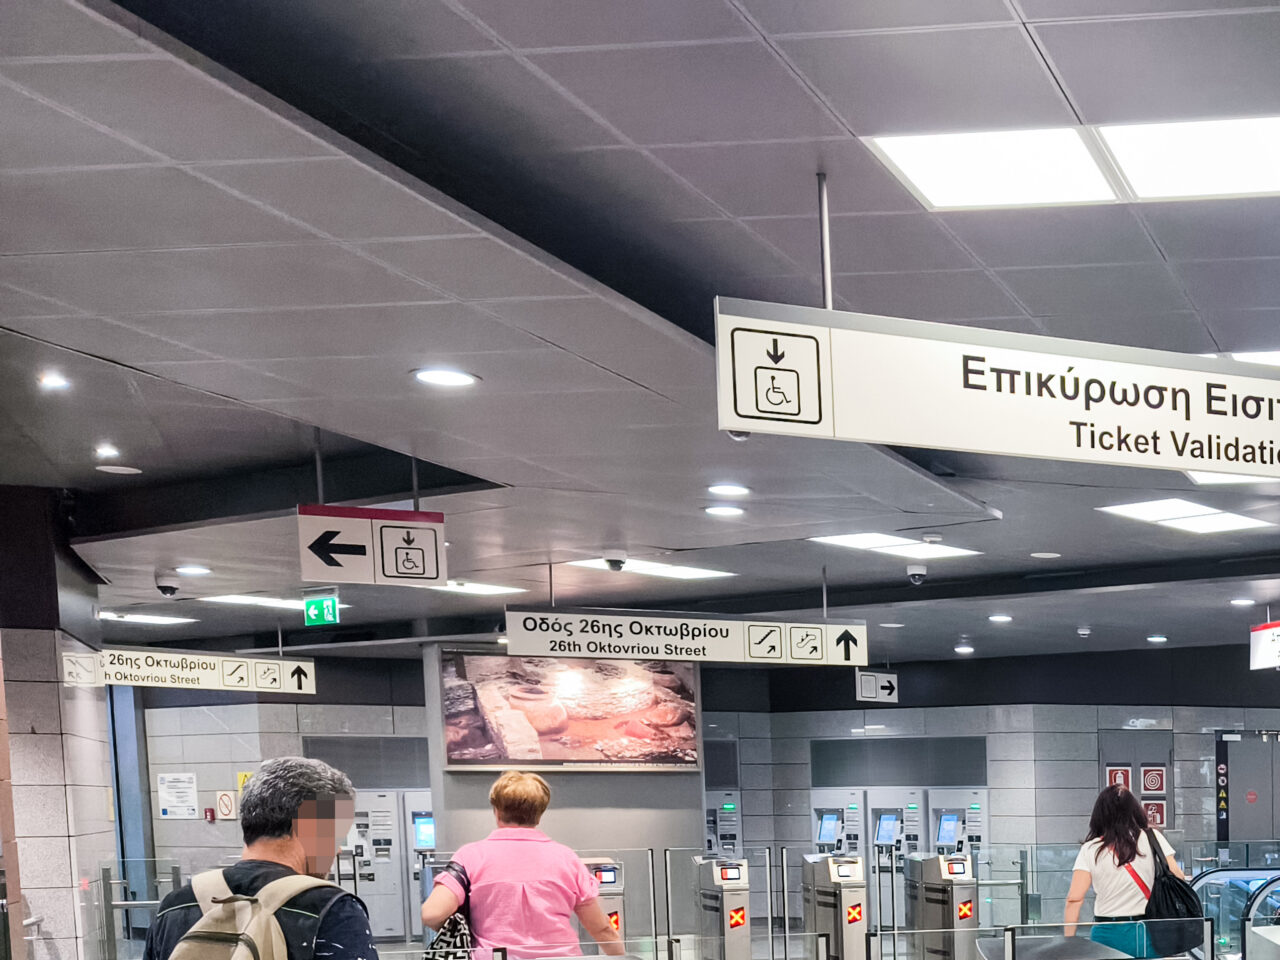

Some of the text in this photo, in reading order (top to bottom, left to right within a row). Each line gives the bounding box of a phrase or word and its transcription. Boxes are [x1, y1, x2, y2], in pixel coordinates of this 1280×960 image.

[962, 354, 1191, 421] Επικύρωση
[1069, 421, 1161, 455] Ticket
[522, 616, 729, 640] Οδός 26ης Οκτωβρίου
[549, 640, 707, 657] 26th Oktovriou Street
[109, 653, 141, 670] 26ης
[145, 655, 216, 672] Οκτωβρίου
[114, 671, 167, 683] Oktovriou
[170, 674, 201, 685] Street
